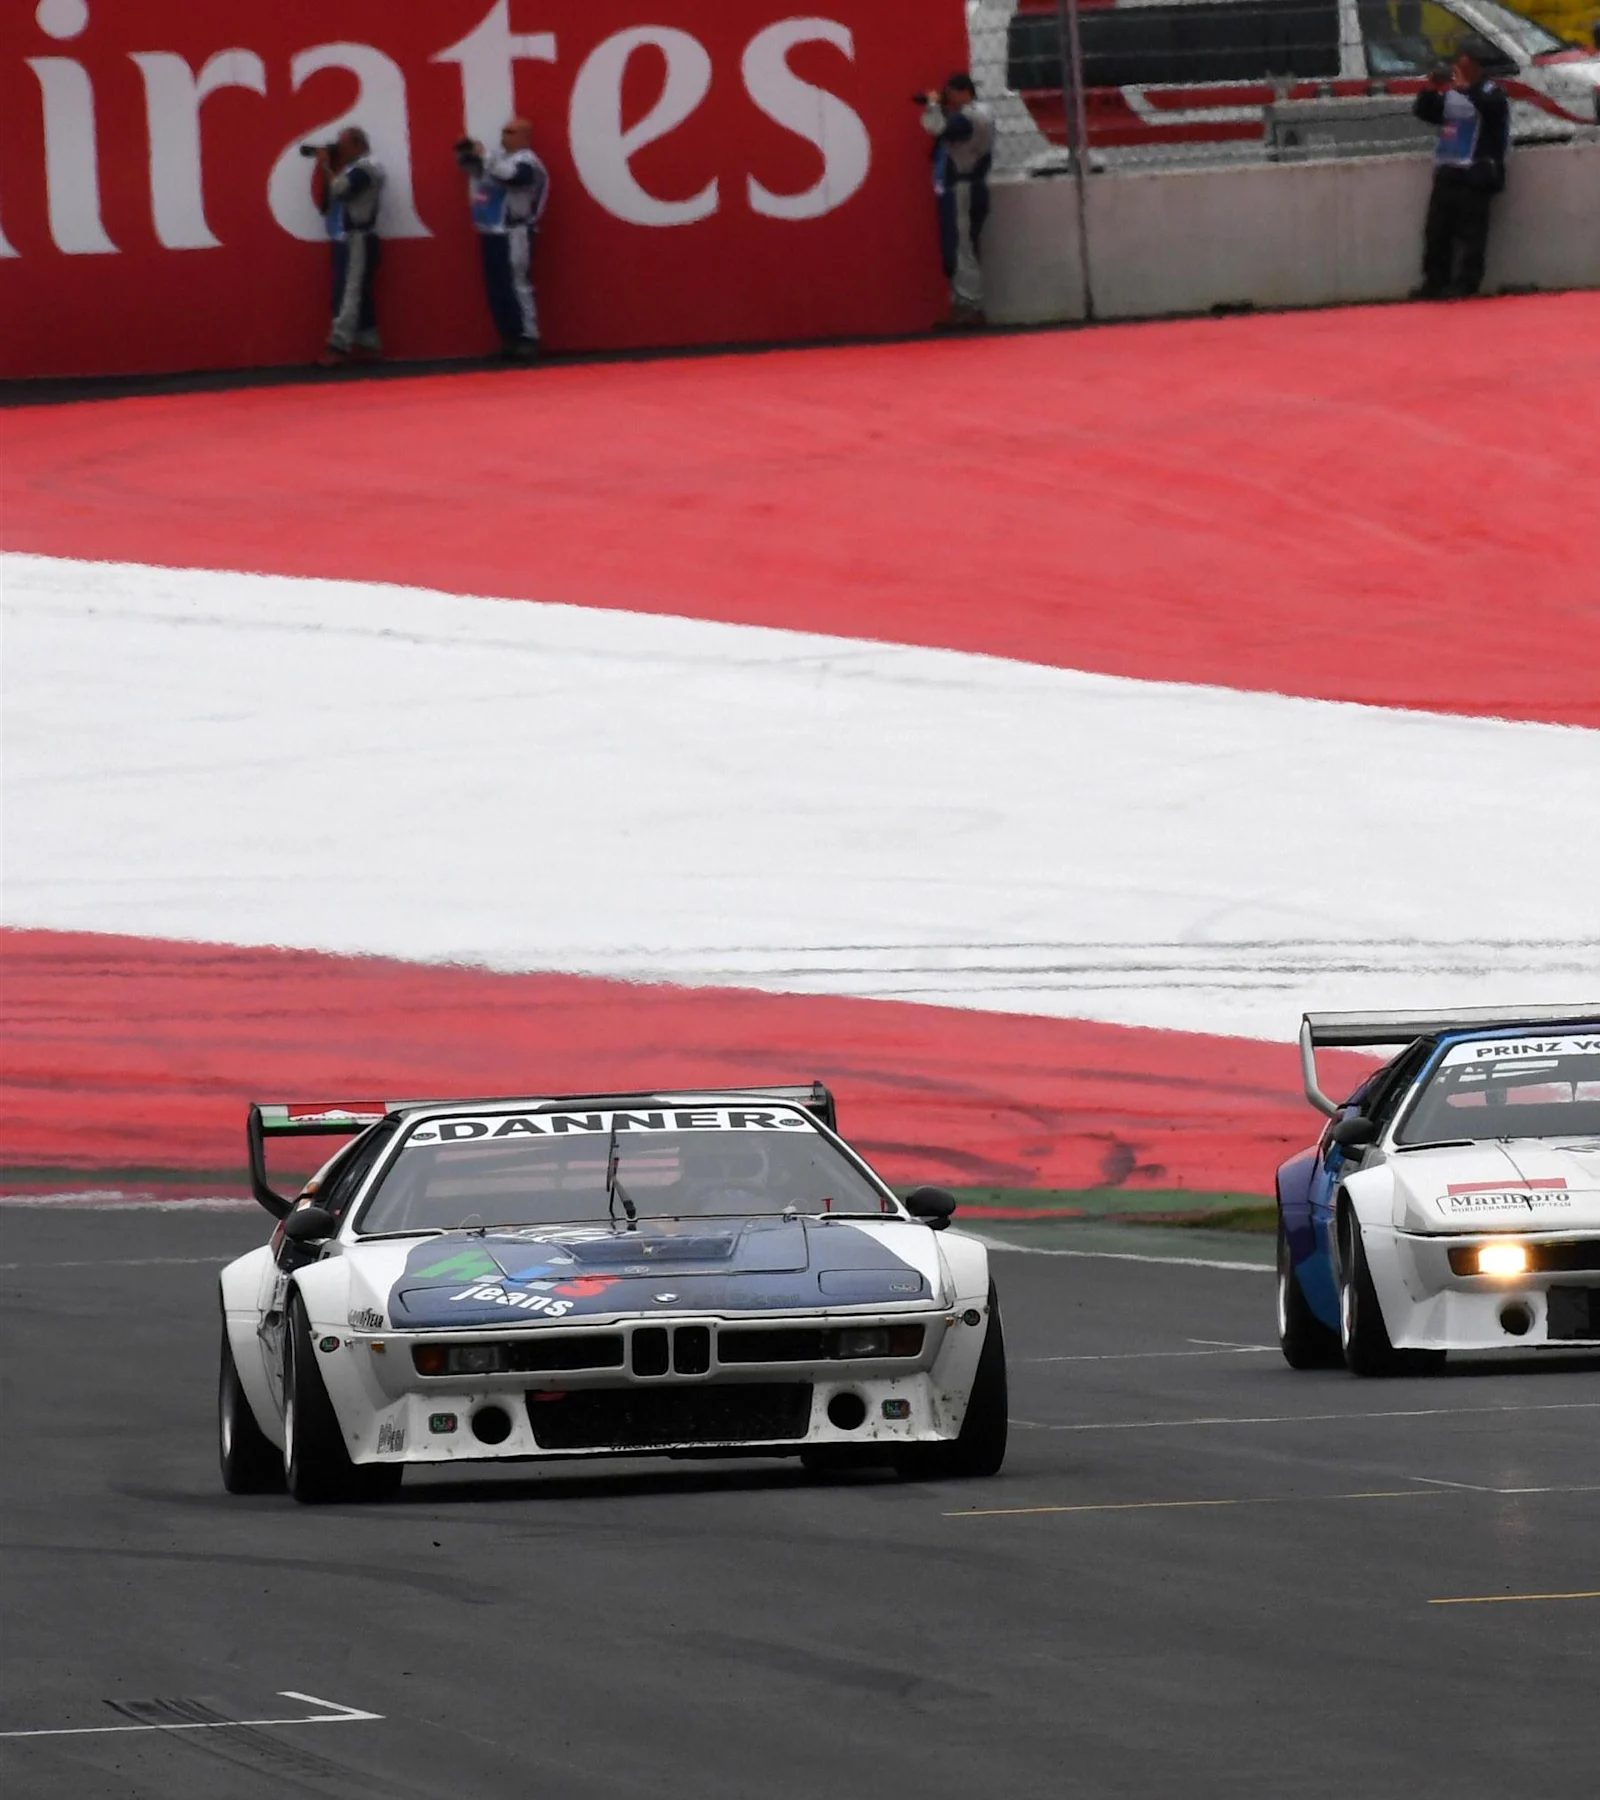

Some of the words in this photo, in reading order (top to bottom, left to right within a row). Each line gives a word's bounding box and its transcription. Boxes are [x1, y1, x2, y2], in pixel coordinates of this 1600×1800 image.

[0, 0, 872, 258] irates
[1476, 1041, 1562, 1058] PRINZ
[438, 1111, 786, 1141] DANNER
[1450, 1193, 1571, 1208] Marlboro
[1483, 1202, 1546, 1212] CHAMPIONHIP
[450, 1283, 575, 1317] jeans
